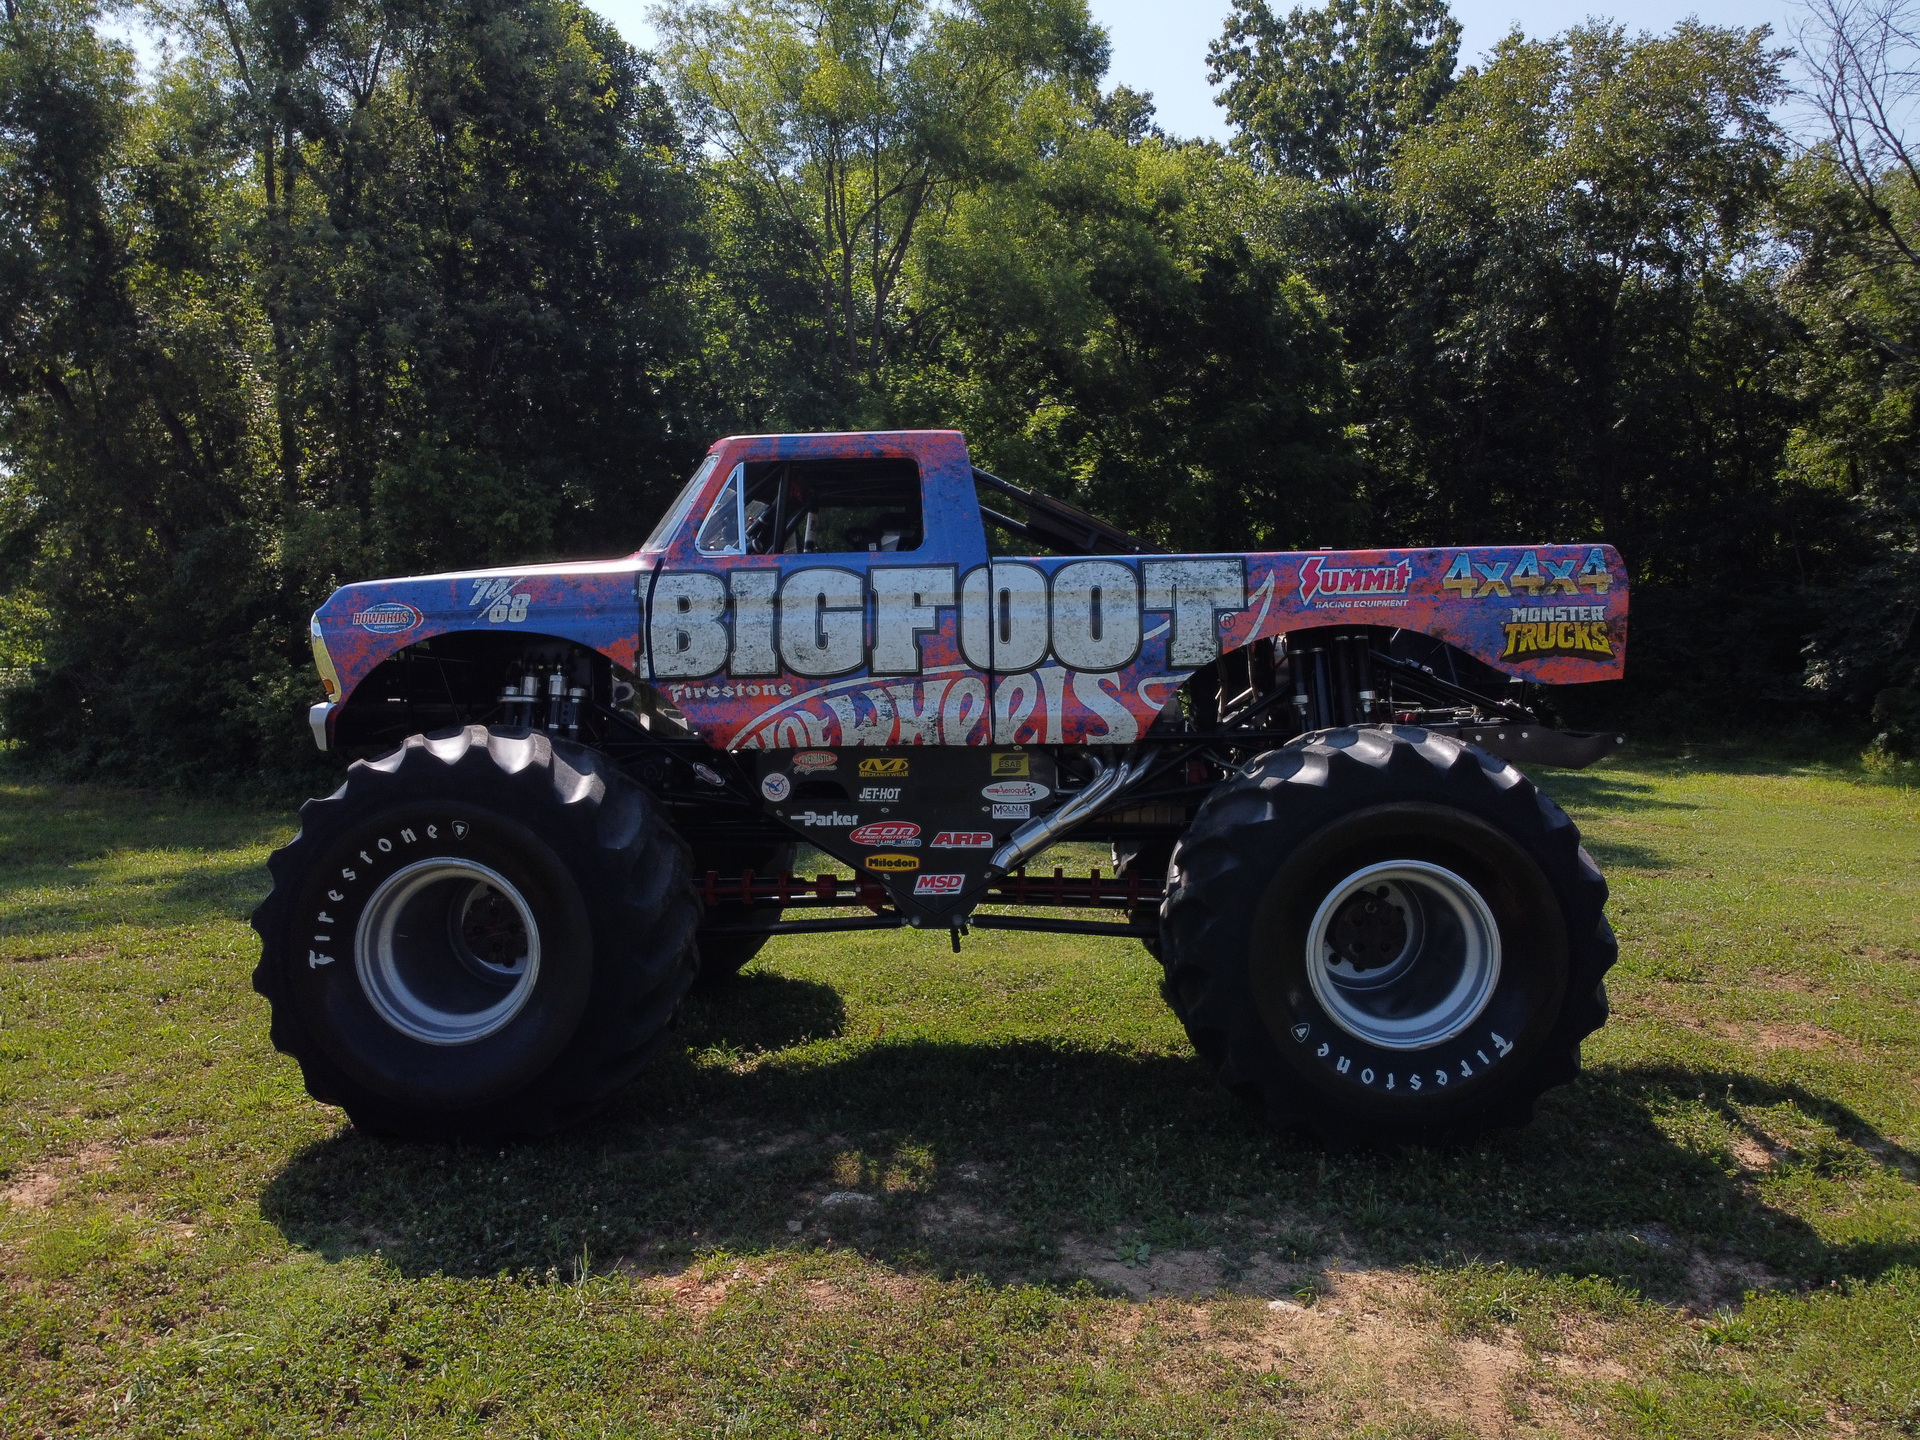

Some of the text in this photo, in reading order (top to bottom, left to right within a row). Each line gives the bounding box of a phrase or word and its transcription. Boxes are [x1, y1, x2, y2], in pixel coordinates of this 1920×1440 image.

[1315, 599, 1409, 609] RACING EQUIPMENT
[353, 612, 409, 626] HOWARDS
[638, 560, 1249, 680] BIGFOOT
[1510, 605, 1607, 622] MONSTER
[1502, 621, 1615, 661] TRUCKS
[668, 683, 793, 703] Firestone
[998, 760, 1022, 768] ESAB
[997, 785, 1030, 795] Aeroquip
[993, 804, 1029, 815] MOLNAR
[804, 810, 859, 826] Parker
[932, 833, 993, 845] ARP
[868, 858, 917, 868] Milodon
[917, 875, 963, 889] MSD
[308, 823, 439, 970] Firestone
[1316, 1031, 1515, 1091] Firestone
